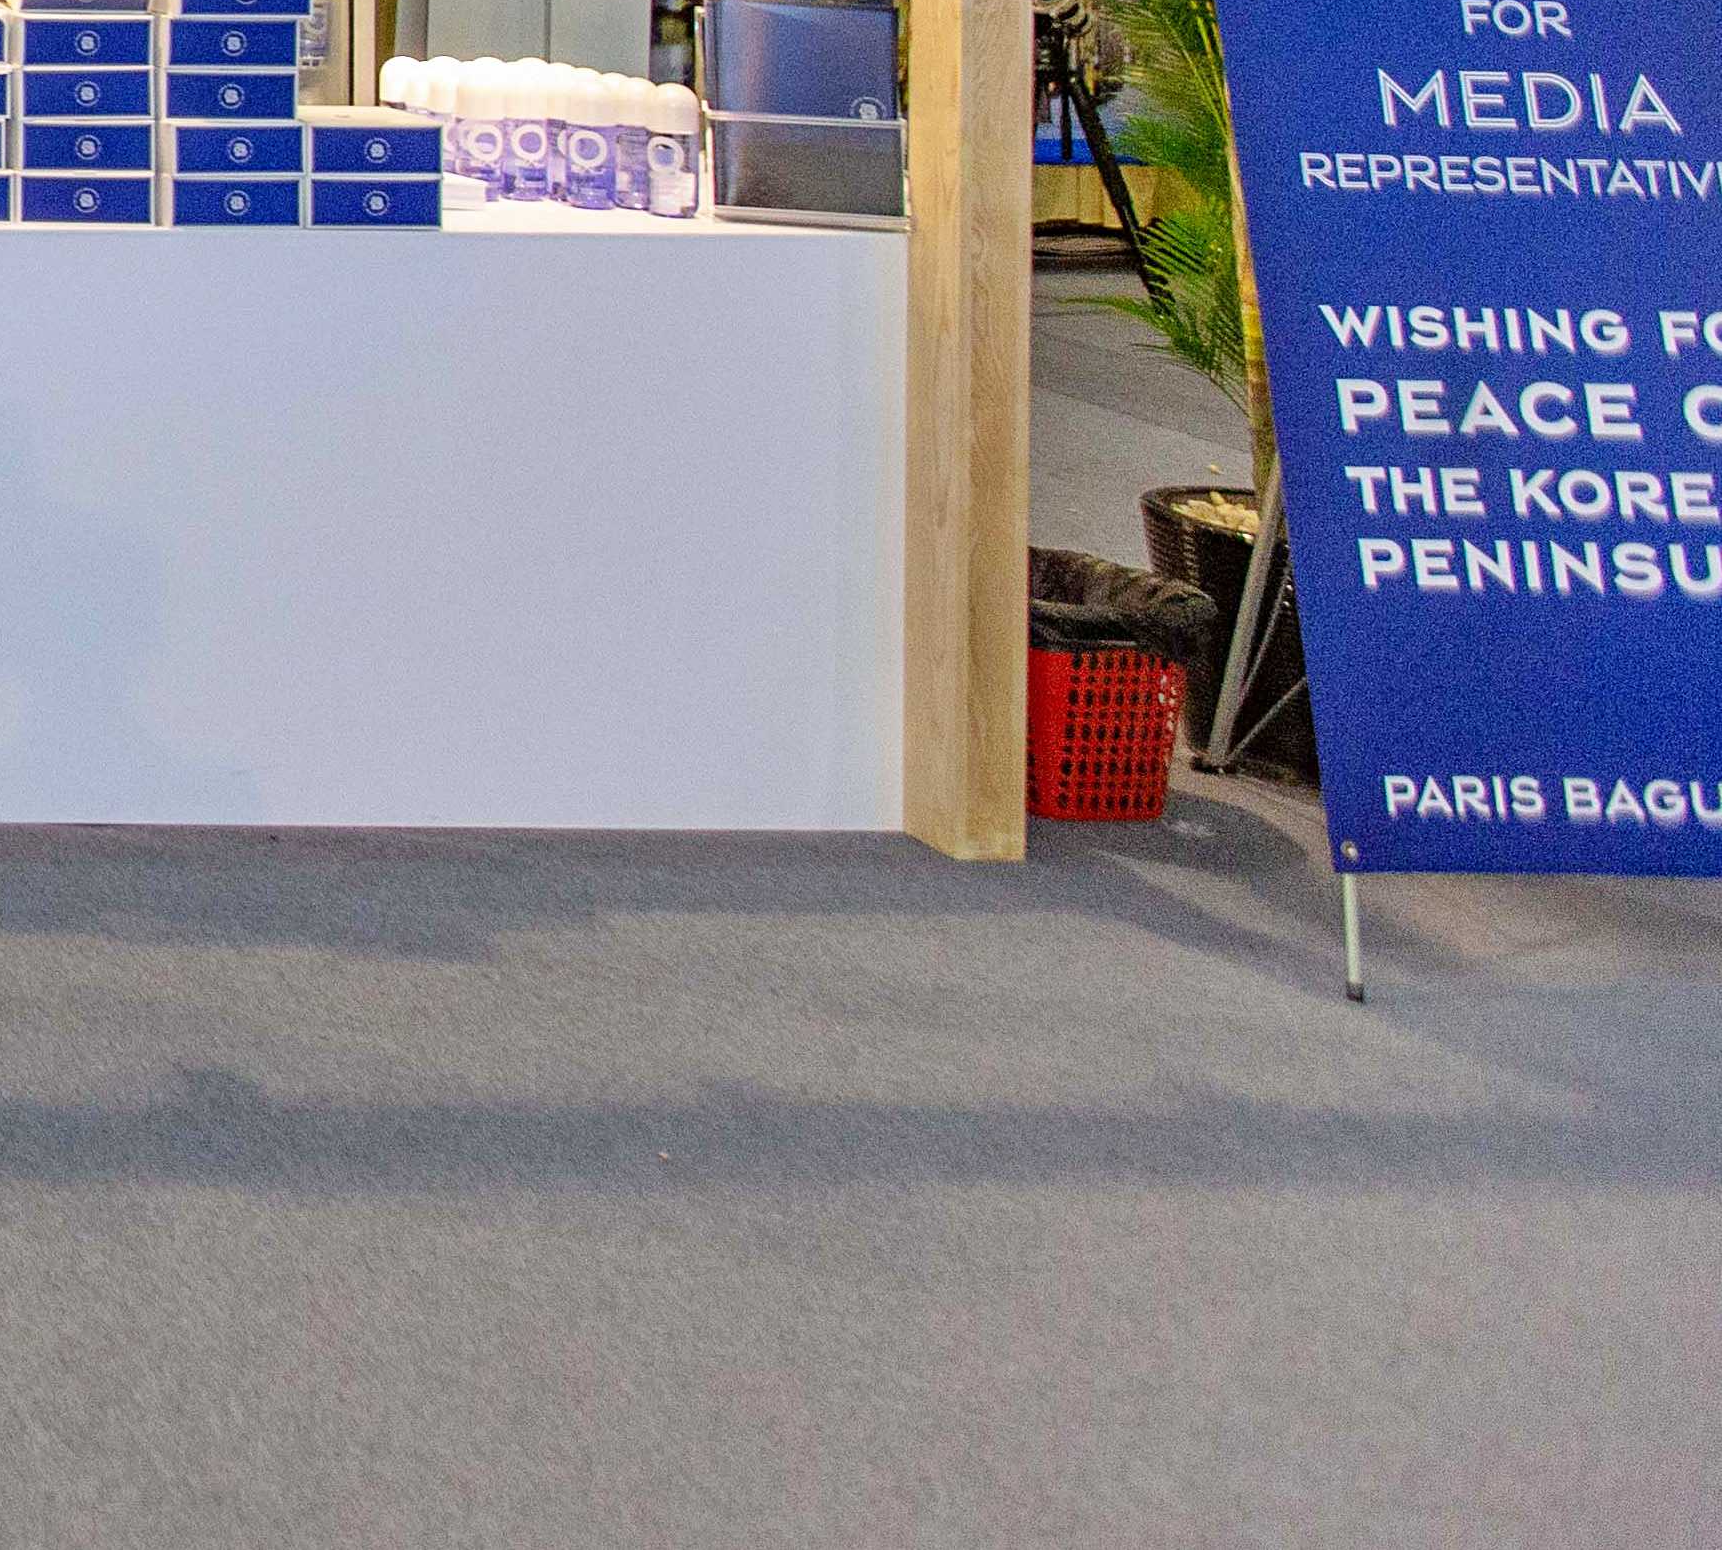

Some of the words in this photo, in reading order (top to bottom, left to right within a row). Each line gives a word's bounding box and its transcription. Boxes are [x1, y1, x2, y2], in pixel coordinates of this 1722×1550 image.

[1461, 0, 1571, 36] FOR
[1378, 68, 1682, 134] MEDIA
[1300, 153, 1722, 200] REPRESENTATIV
[1319, 305, 1628, 353] WISHING
[1336, 379, 1641, 439] PEACE
[1684, 385, 1722, 442] O
[1345, 466, 1484, 515] THE
[1510, 469, 1719, 522] KORE
[1358, 538, 1722, 598] PENINSU
[1384, 776, 1544, 817] PARIS
[1563, 777, 1722, 825] BAGU
